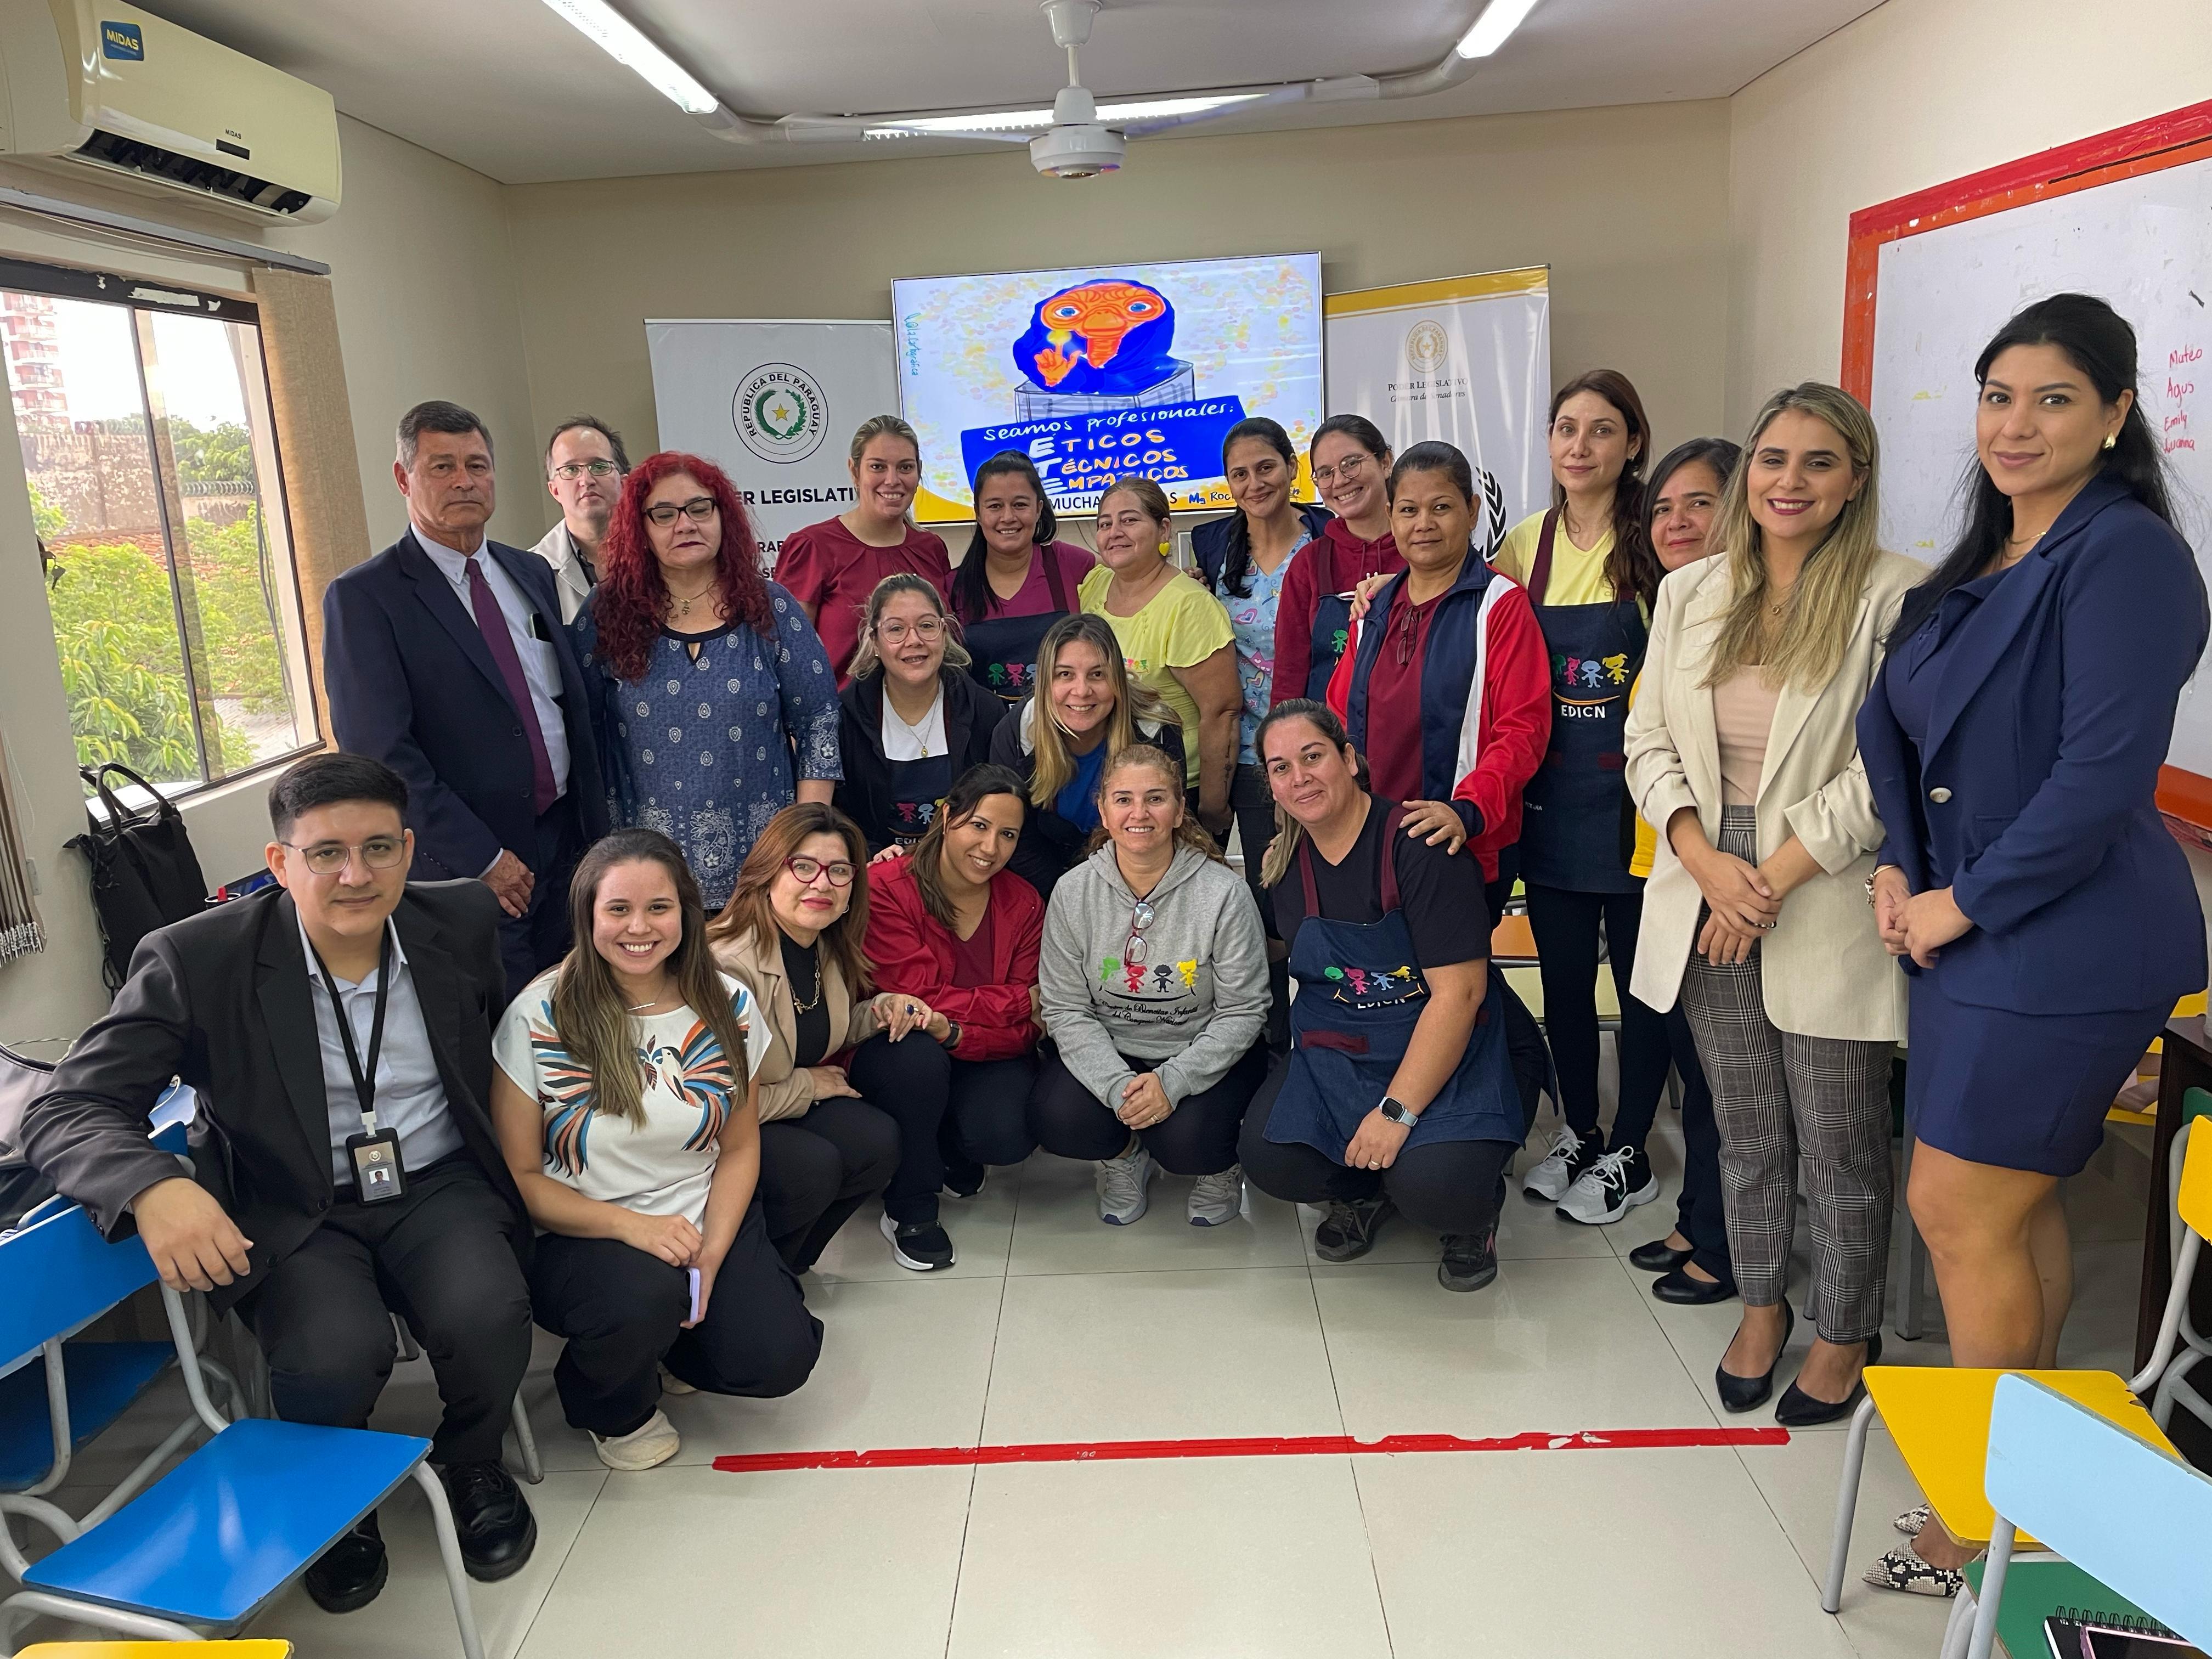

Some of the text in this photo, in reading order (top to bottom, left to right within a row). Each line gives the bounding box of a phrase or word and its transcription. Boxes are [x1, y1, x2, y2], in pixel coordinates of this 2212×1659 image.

[106, 29, 139, 50] MIDAS
[225, 128, 241, 139] MIDAS
[2169, 345, 2203, 368] Mateo
[2166, 376, 2194, 408] Agus
[742, 374, 820, 437] REPUBLICA DEL PARAGUAY
[2164, 410, 2187, 432] Emily
[760, 487, 854, 504] LEGISLATI
[1561, 704, 1606, 718] EDICN
